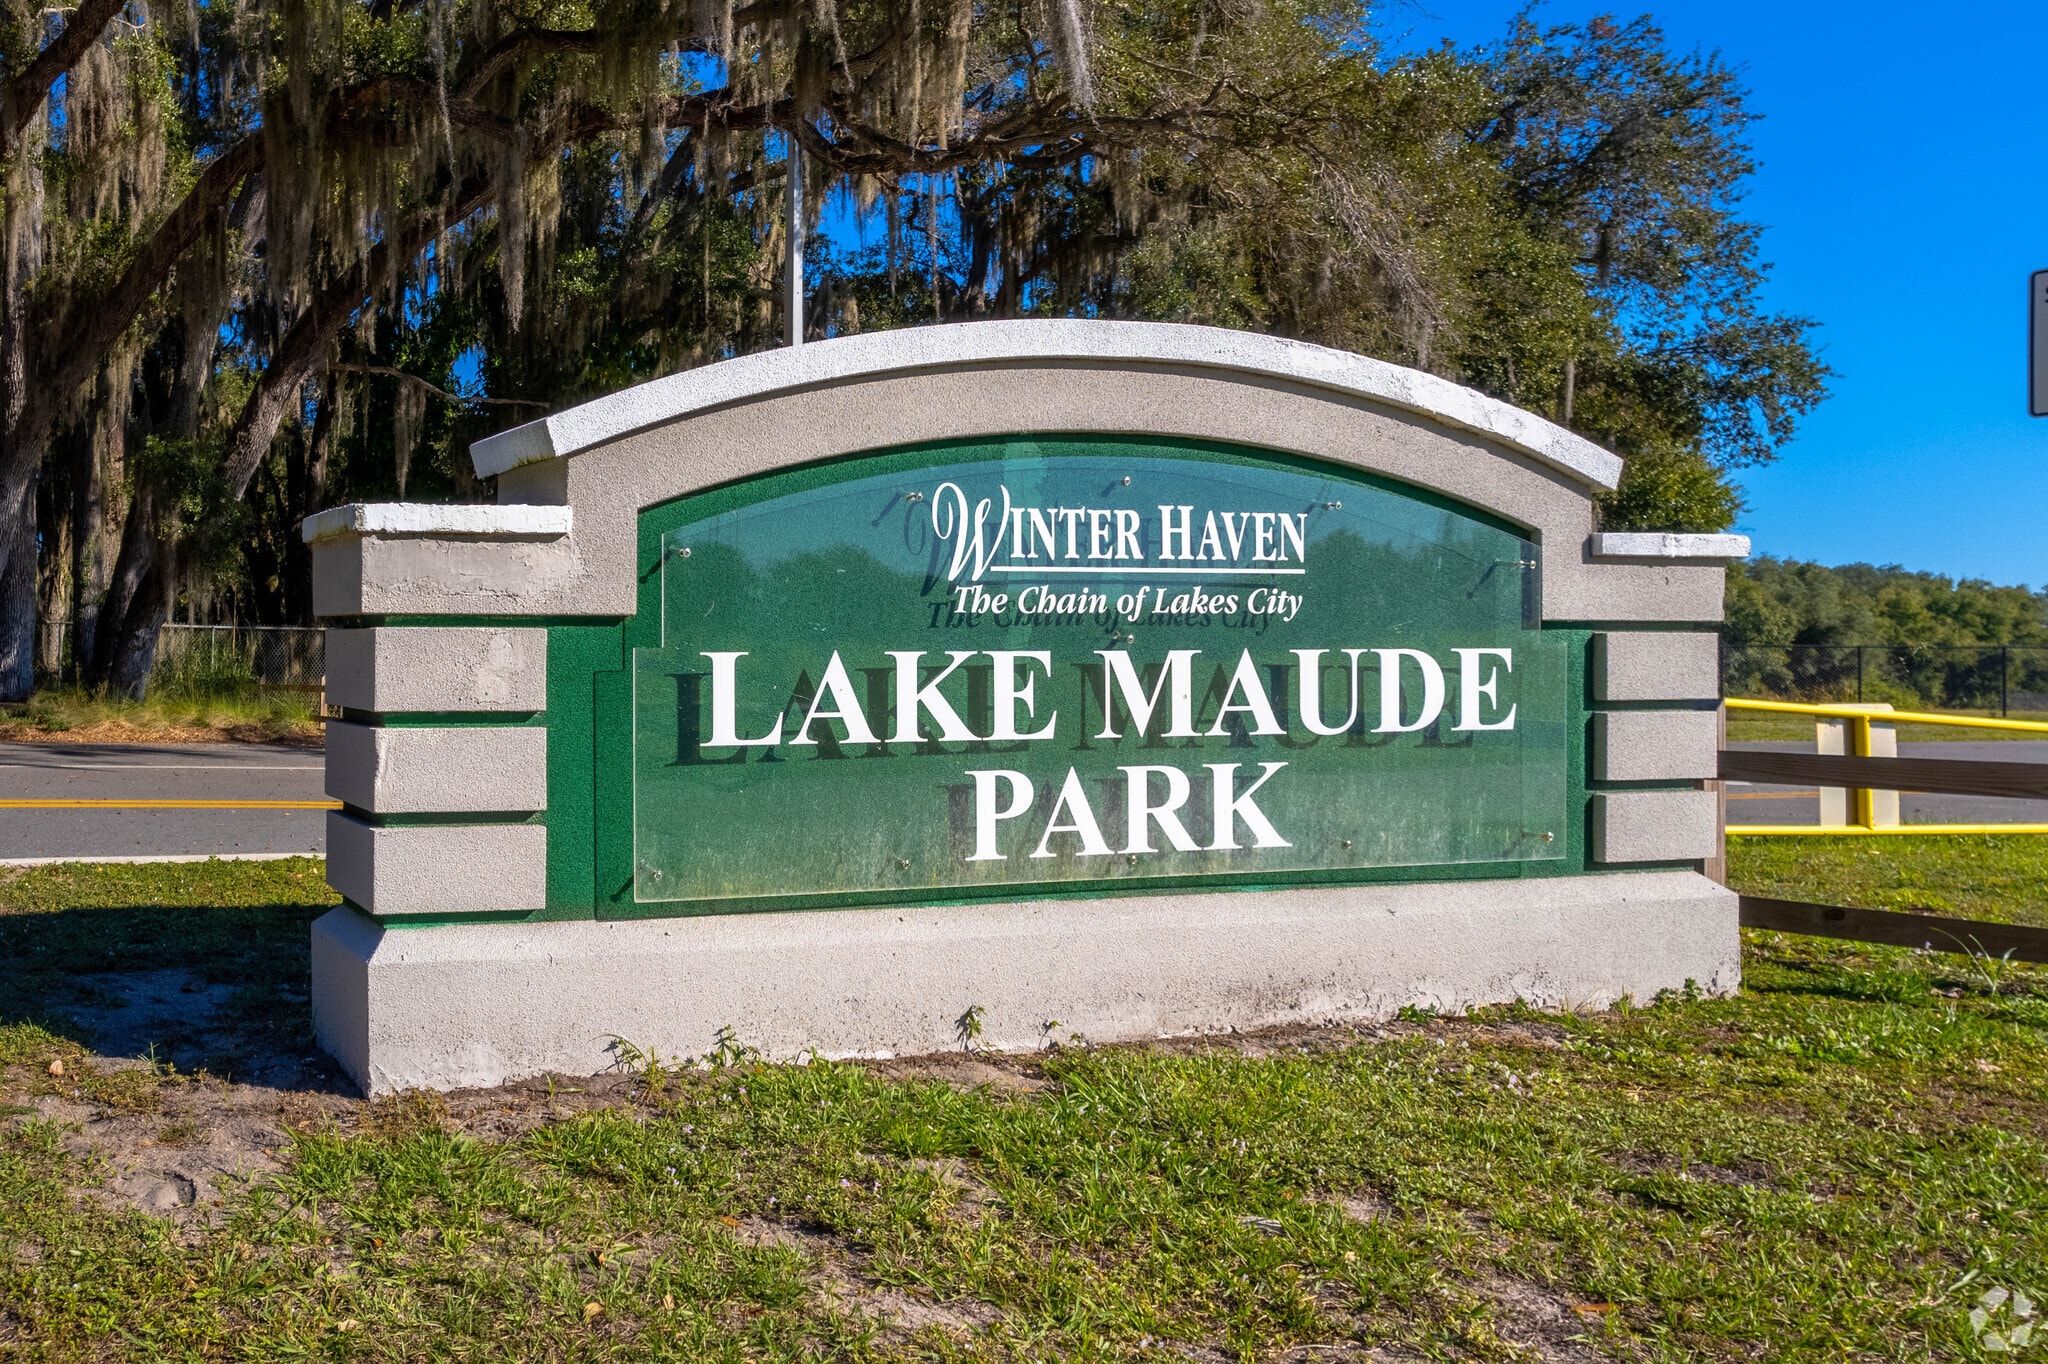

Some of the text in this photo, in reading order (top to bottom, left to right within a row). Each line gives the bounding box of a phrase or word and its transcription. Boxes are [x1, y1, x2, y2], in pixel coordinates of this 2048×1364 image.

[954, 584, 1303, 622] The Chain of Lakes City
[700, 648, 1516, 747] LAKE MAUDE
[965, 761, 1293, 862] PARK
